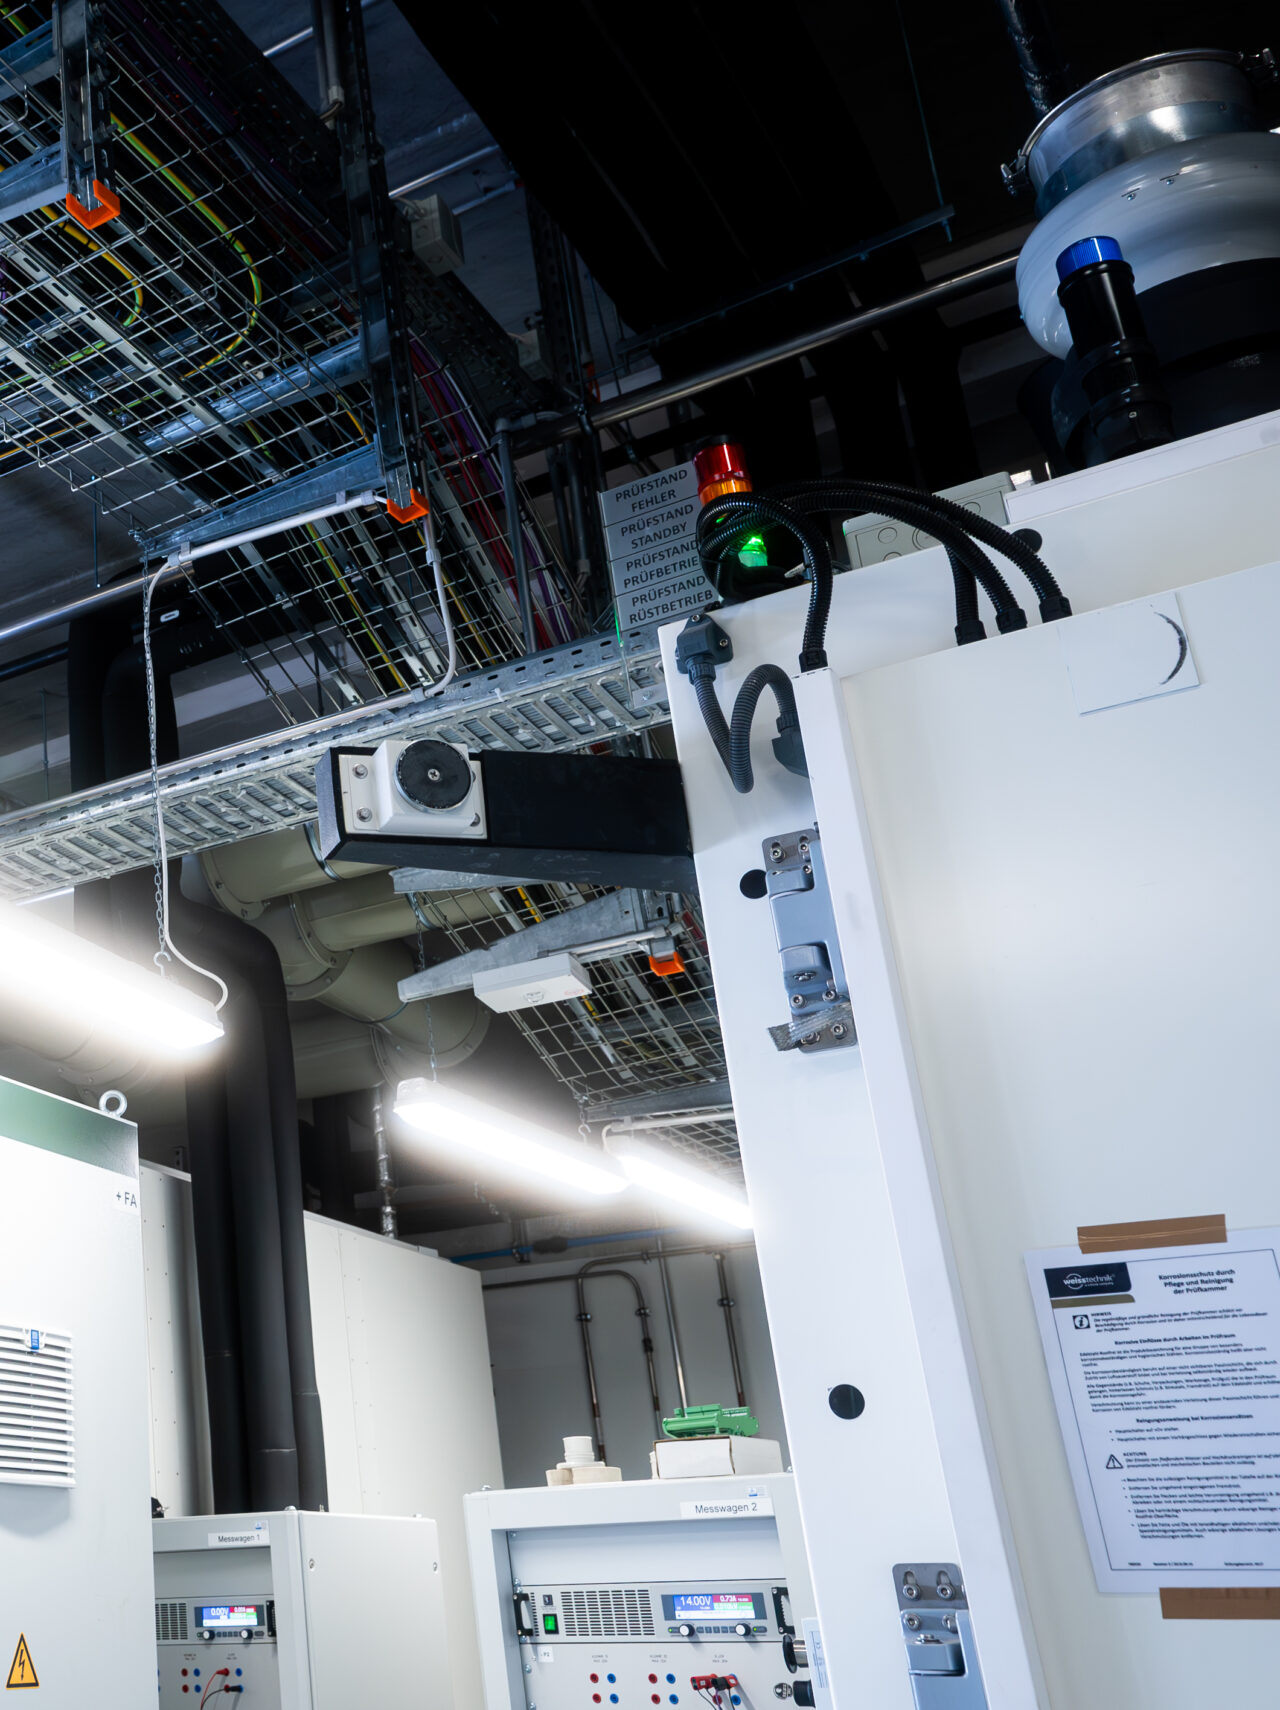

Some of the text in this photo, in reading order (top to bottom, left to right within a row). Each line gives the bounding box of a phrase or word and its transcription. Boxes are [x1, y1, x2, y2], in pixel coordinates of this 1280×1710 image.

[615, 469, 688, 502] PRÜFSTAND
[631, 489, 677, 512] FEHLER
[621, 503, 694, 537] PRÜFSTAND
[631, 521, 688, 549] STANDBY
[623, 557, 699, 588] PRÜFBETRIE
[632, 575, 706, 607] PRÜFSTAND
[629, 590, 714, 624] RÜSTBETRIEB
[1158, 1268, 1235, 1280] Korrosionsschutz durch
[1163, 1279, 1185, 1288] Pflege
[1200, 1276, 1234, 1286] Reinigung
[1185, 1285, 1228, 1294] Prüfkammer
[695, 1502, 758, 1514] Messwagen 2
[218, 1535, 255, 1543] Messwagen
[680, 1595, 712, 1607] 14.00V
